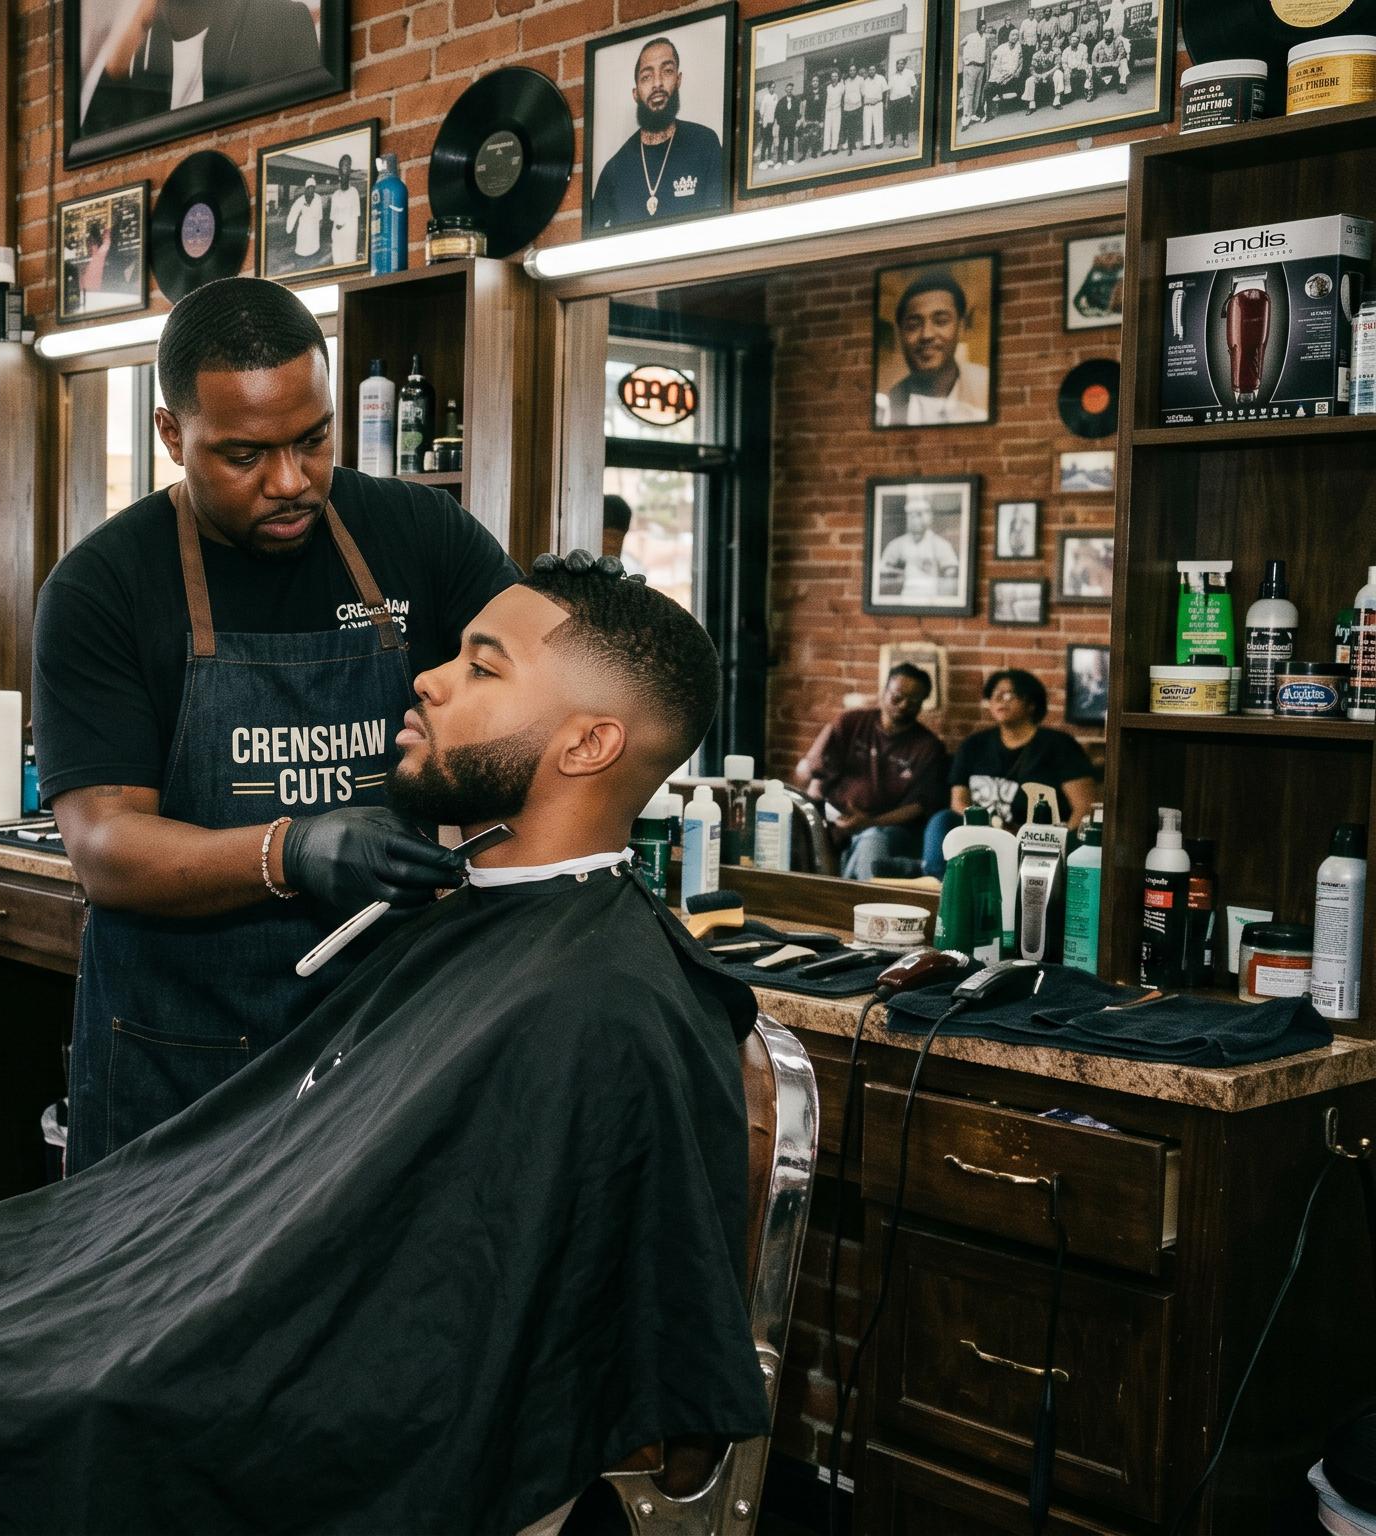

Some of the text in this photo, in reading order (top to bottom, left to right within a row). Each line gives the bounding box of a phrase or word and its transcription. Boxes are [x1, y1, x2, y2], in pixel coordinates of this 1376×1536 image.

[336, 598, 409, 621] CREHAW
[232, 718, 386, 764] CRENSHAW
[279, 765, 353, 805] CUTS
